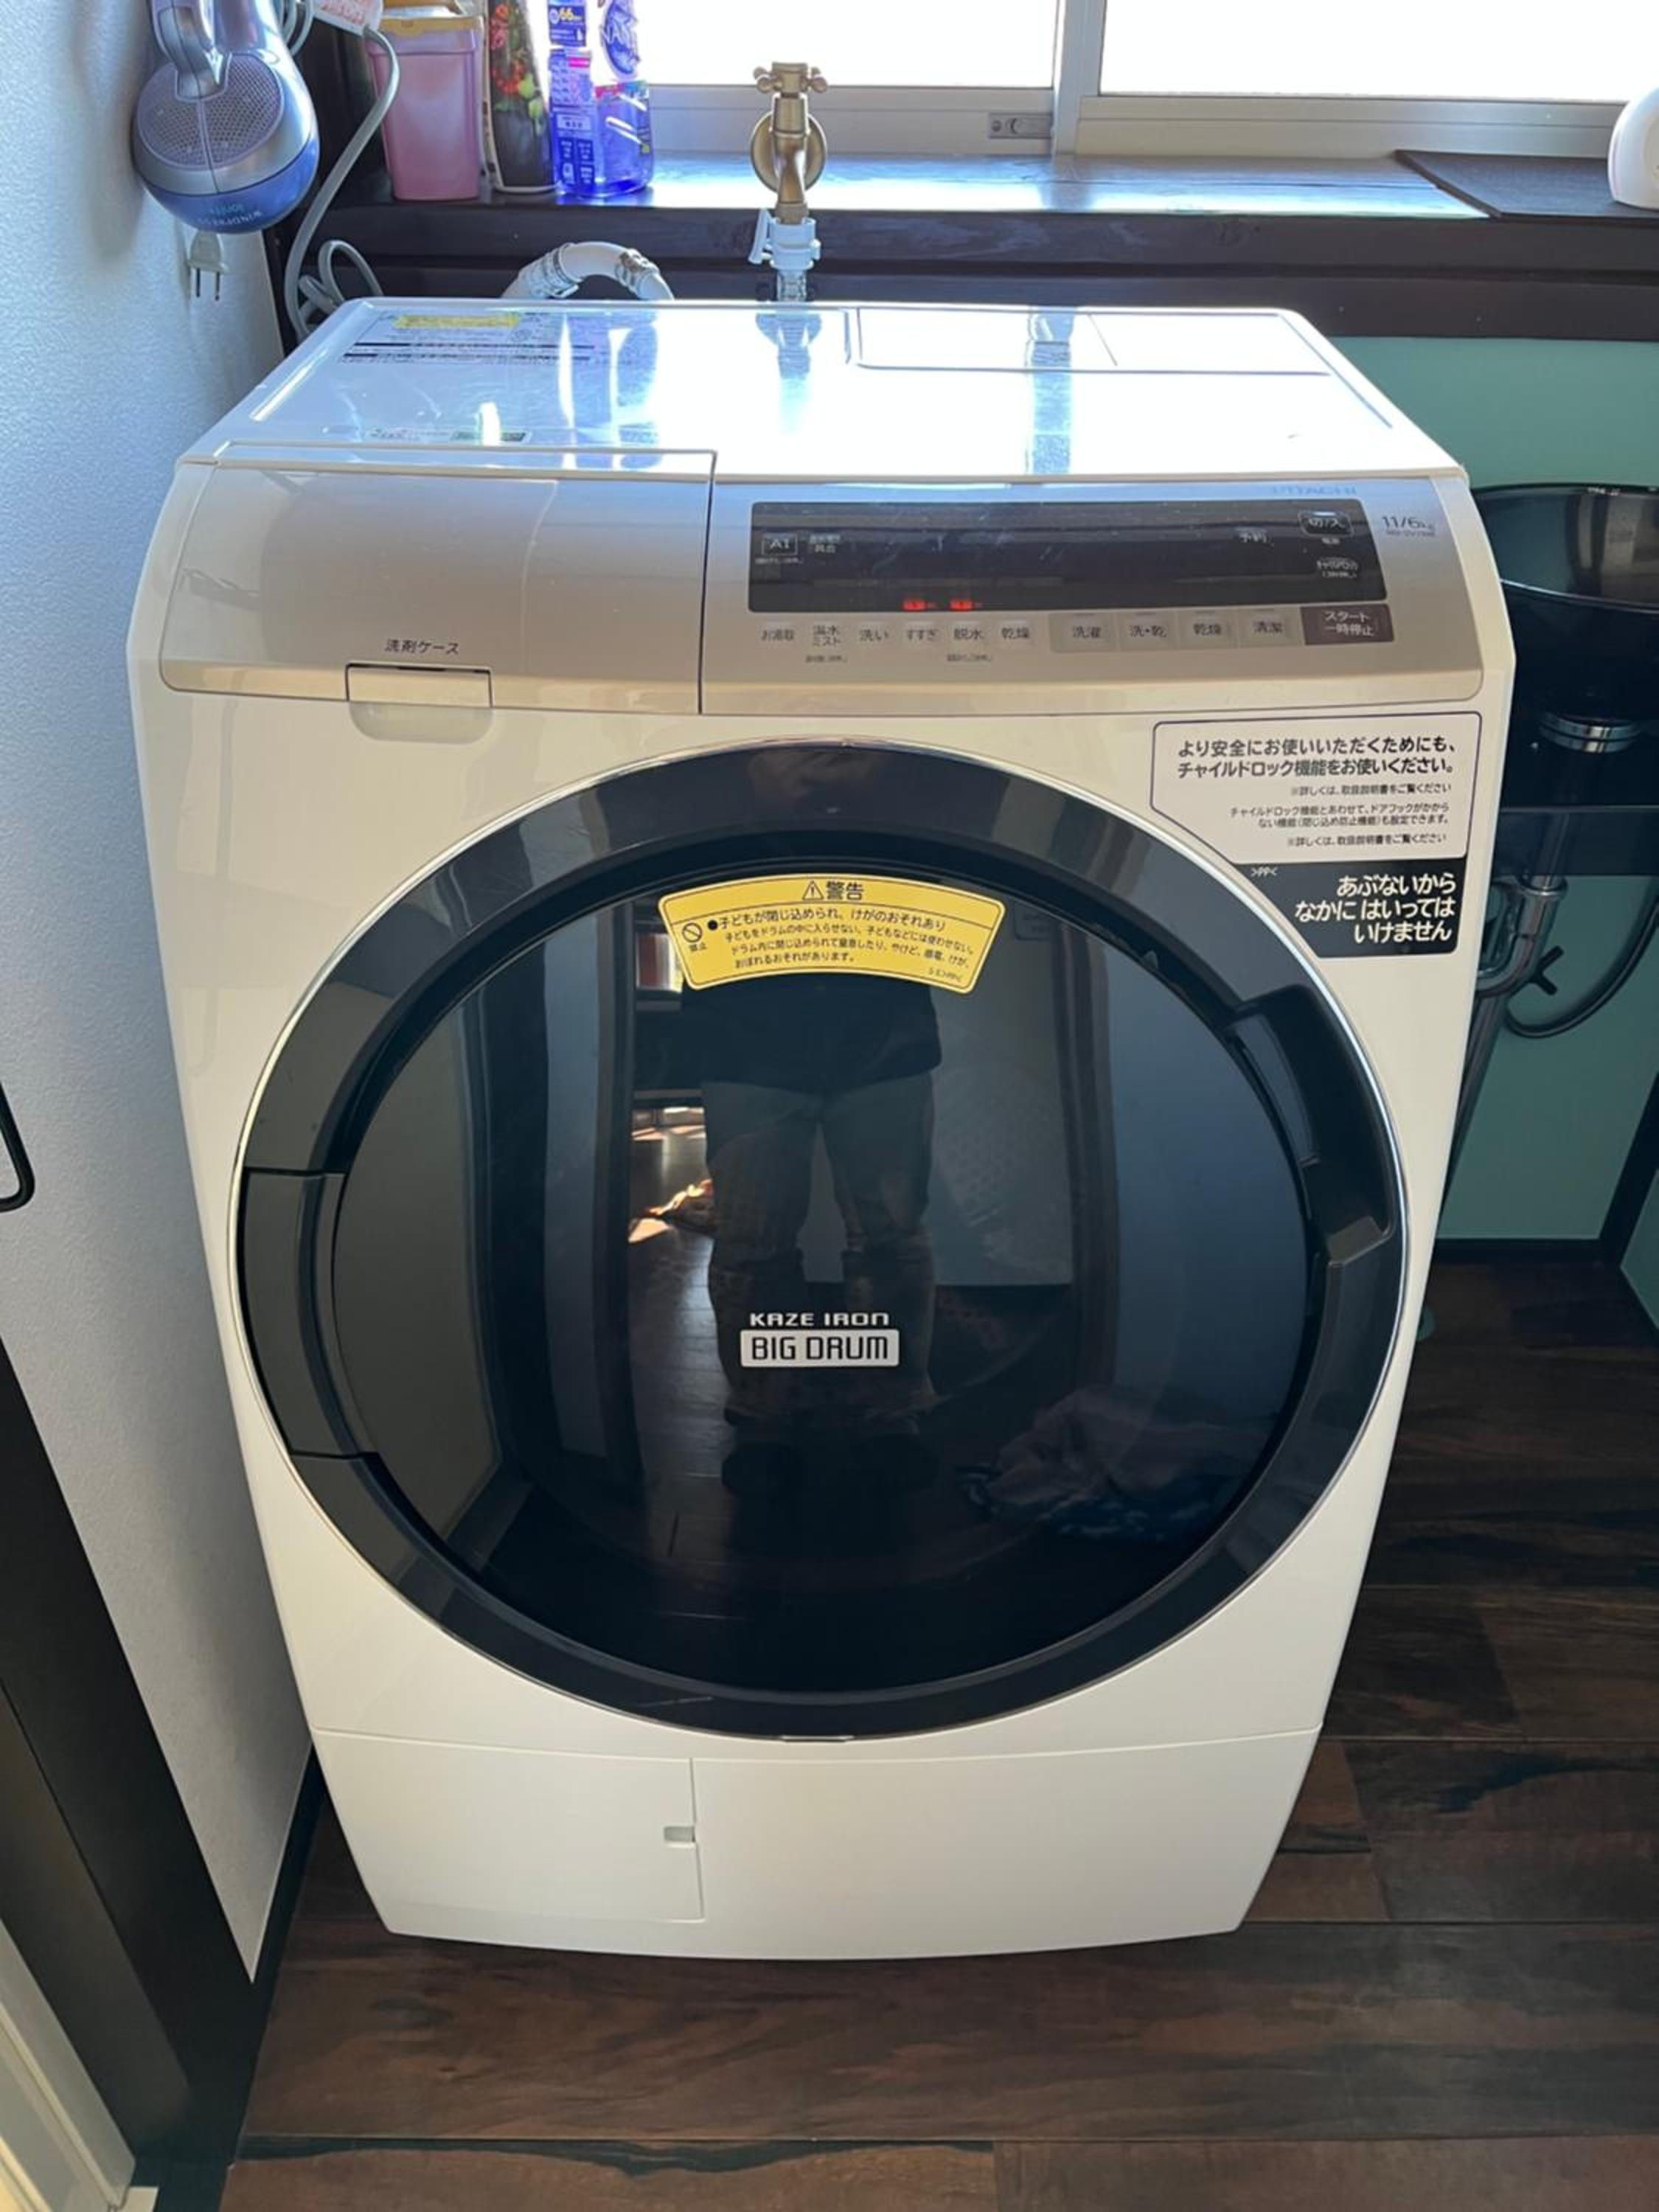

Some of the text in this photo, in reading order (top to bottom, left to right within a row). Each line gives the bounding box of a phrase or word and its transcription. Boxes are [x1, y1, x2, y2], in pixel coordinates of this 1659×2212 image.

[1326, 611, 1369, 622] スタート
[860, 629, 889, 642] 洗い
[954, 627, 985, 640] 脱水
[1001, 627, 1029, 639] 乾燥
[1073, 625, 1102, 639] 洗濯
[1193, 623, 1222, 636] 乾燥
[1325, 623, 1375, 637] 一時停止
[384, 639, 459, 655] 洗剤ケース
[1178, 736, 1455, 757] より安全にお使いいただくためにも、
[1178, 757, 1453, 779] チャイルドロック機能をお使いください。
[827, 881, 864, 900] 警告
[1337, 873, 1456, 897] あぶないから
[1354, 920, 1453, 943] いけません
[750, 1312, 890, 1326] KAZE IRON
[752, 1336, 888, 1360] BIG DRUM
